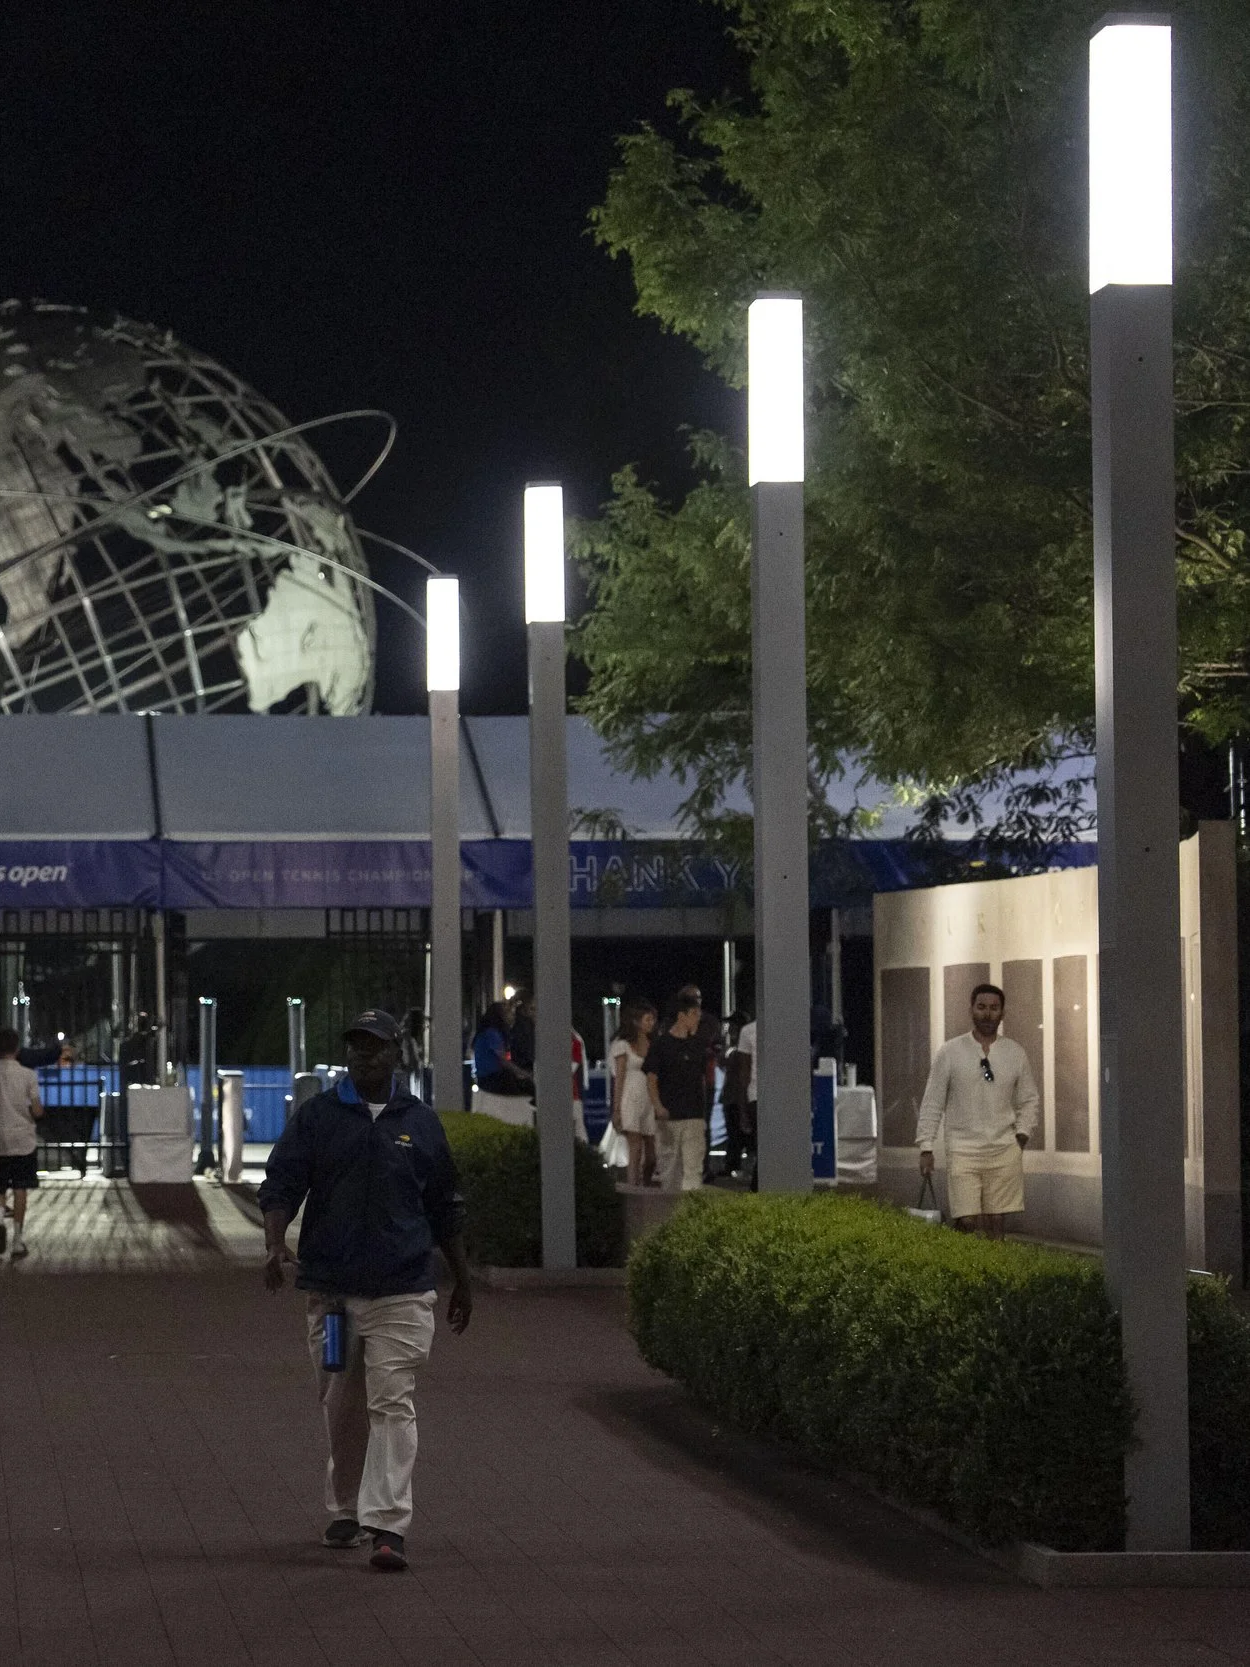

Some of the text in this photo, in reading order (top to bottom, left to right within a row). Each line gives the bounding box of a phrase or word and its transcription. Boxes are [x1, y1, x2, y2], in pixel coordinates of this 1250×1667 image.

[8, 865, 68, 888] open
[229, 868, 275, 882] OPEN
[282, 868, 341, 883] TENNIS
[569, 854, 700, 893] HANK
